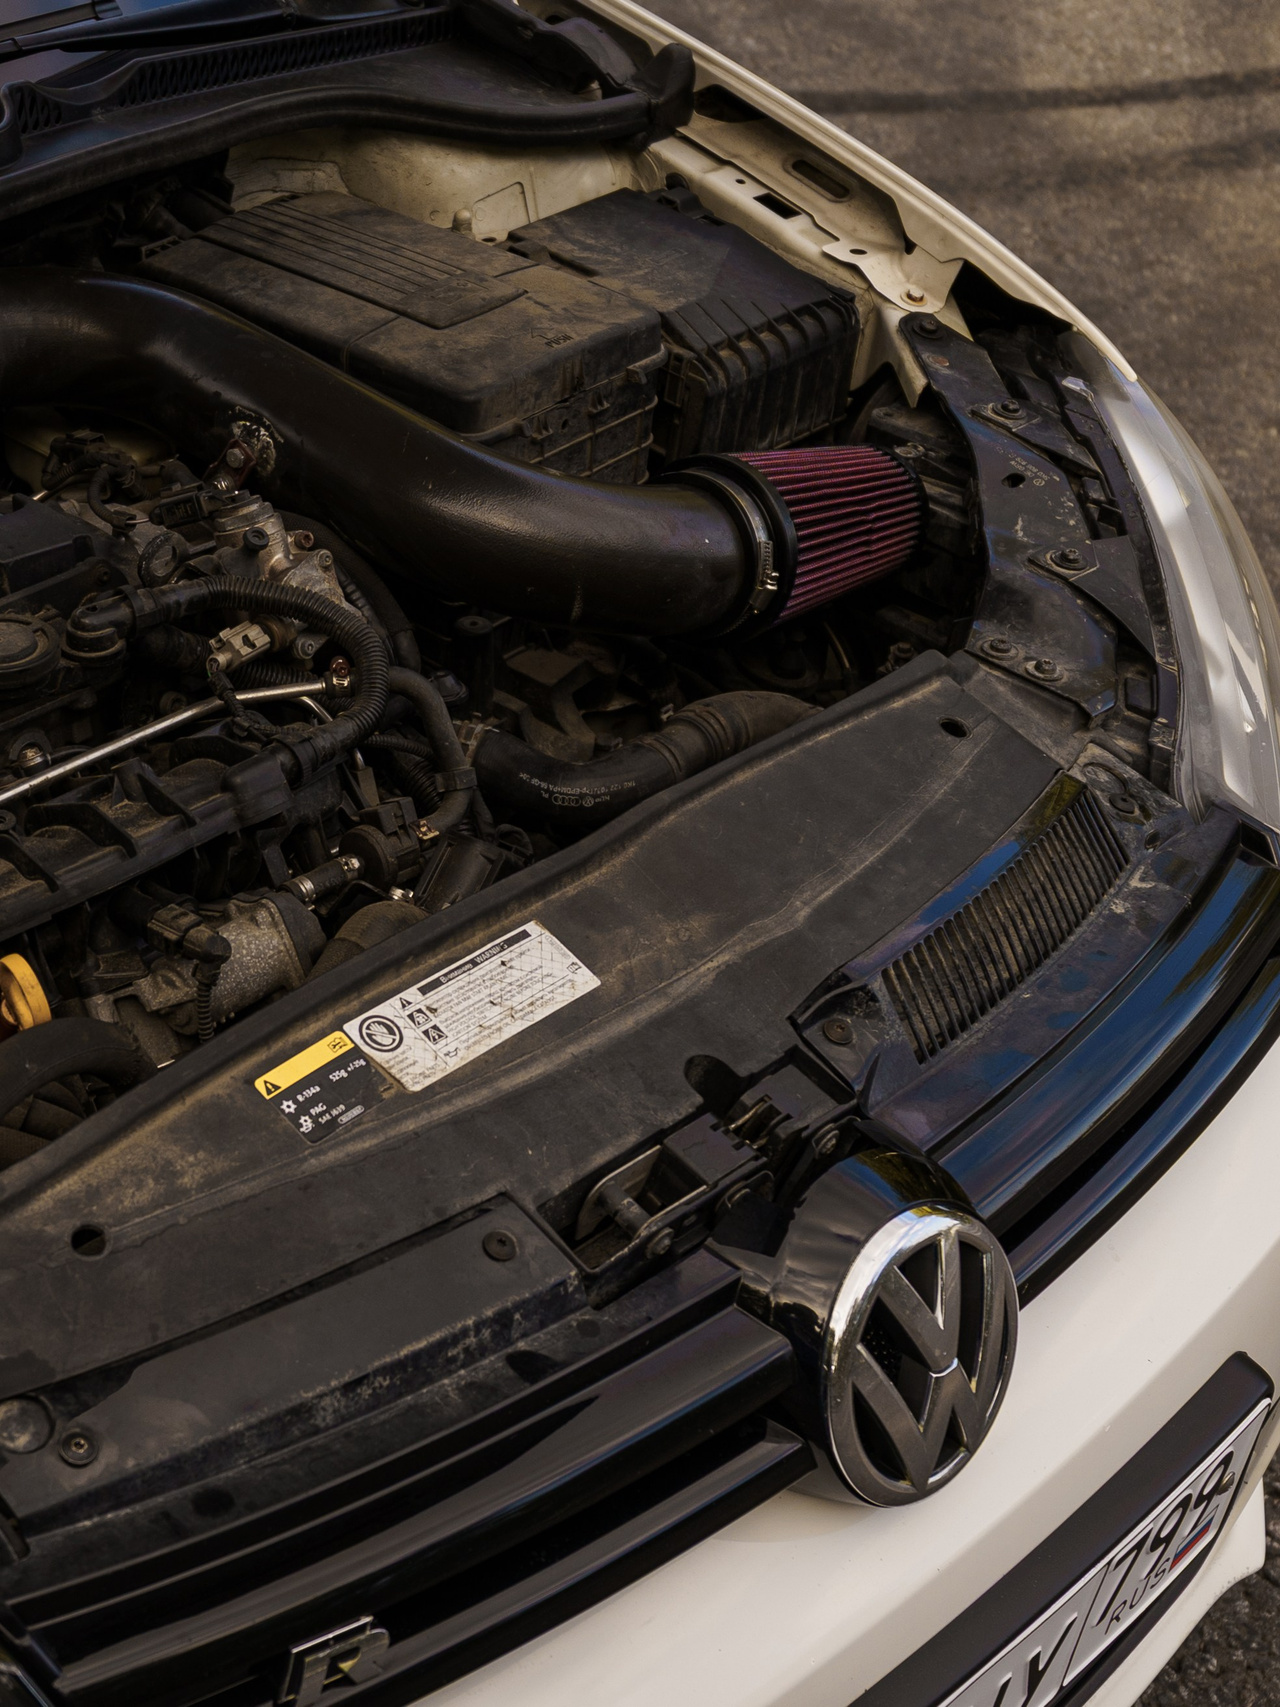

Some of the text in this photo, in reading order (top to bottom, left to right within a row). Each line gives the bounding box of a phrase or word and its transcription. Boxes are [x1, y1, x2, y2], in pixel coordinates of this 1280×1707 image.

[296, 1085, 321, 1102] R-134a
[309, 1102, 327, 1117] PAG
[1095, 1447, 1235, 1627] 799
[1105, 1557, 1171, 1635] RUS
